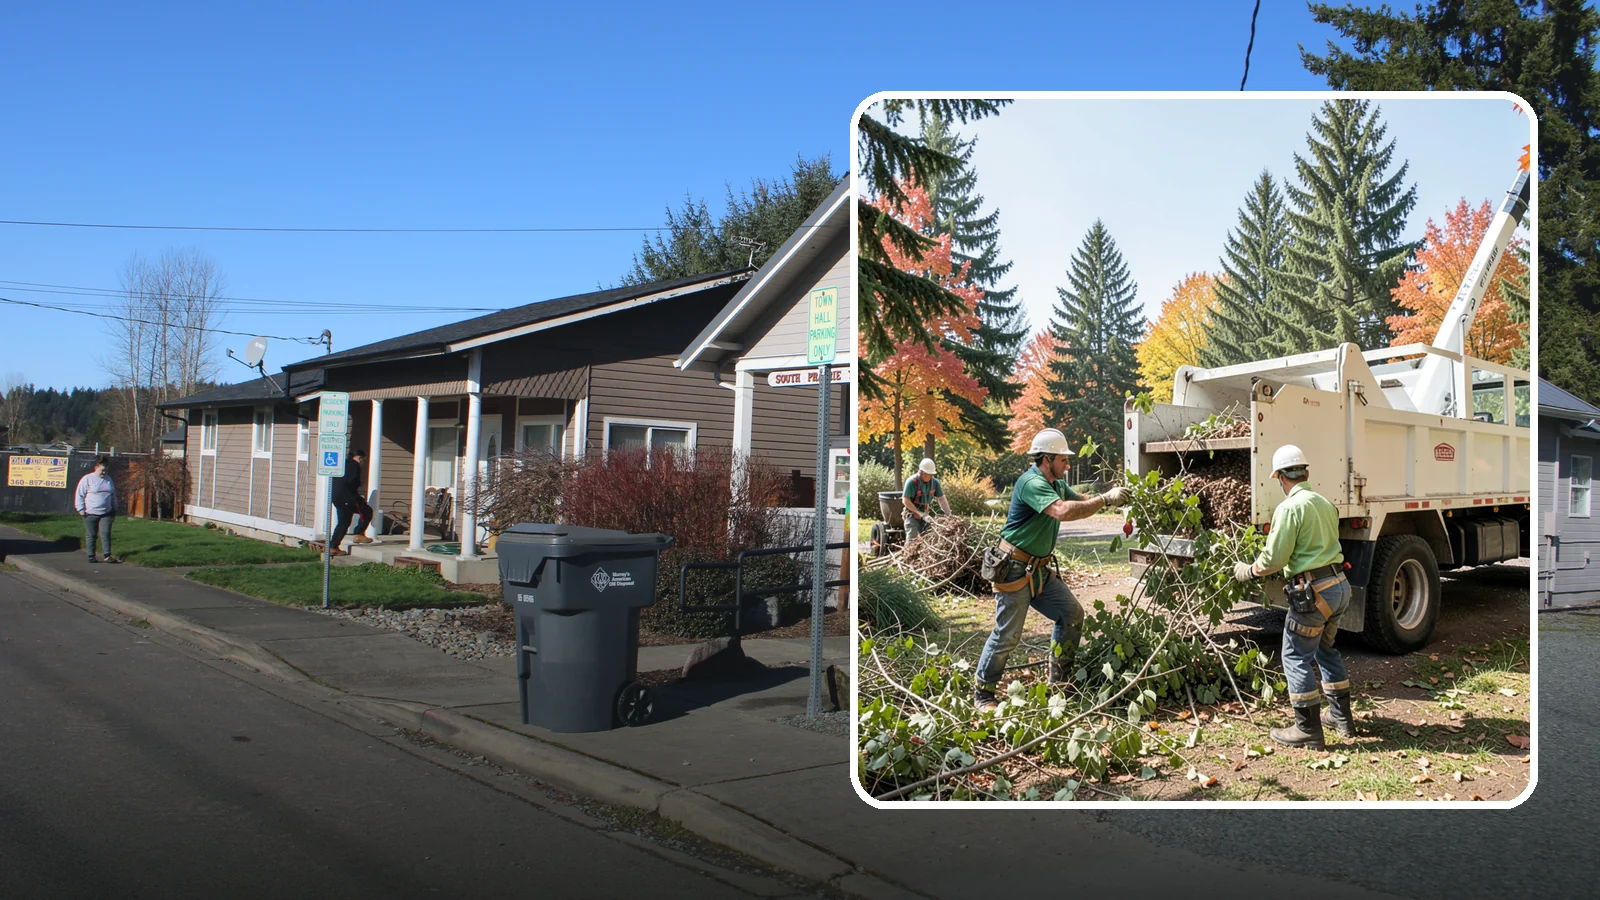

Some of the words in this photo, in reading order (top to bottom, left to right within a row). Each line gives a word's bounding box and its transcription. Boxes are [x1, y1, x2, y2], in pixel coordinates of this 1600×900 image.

[815, 295, 833, 308] TOWN
[815, 312, 831, 324] HALL
[810, 327, 835, 340] PARKING
[814, 344, 831, 357] ONLY
[775, 373, 801, 384] SOUTH
[808, 370, 842, 382] PRIE
[325, 420, 340, 428] ONLY
